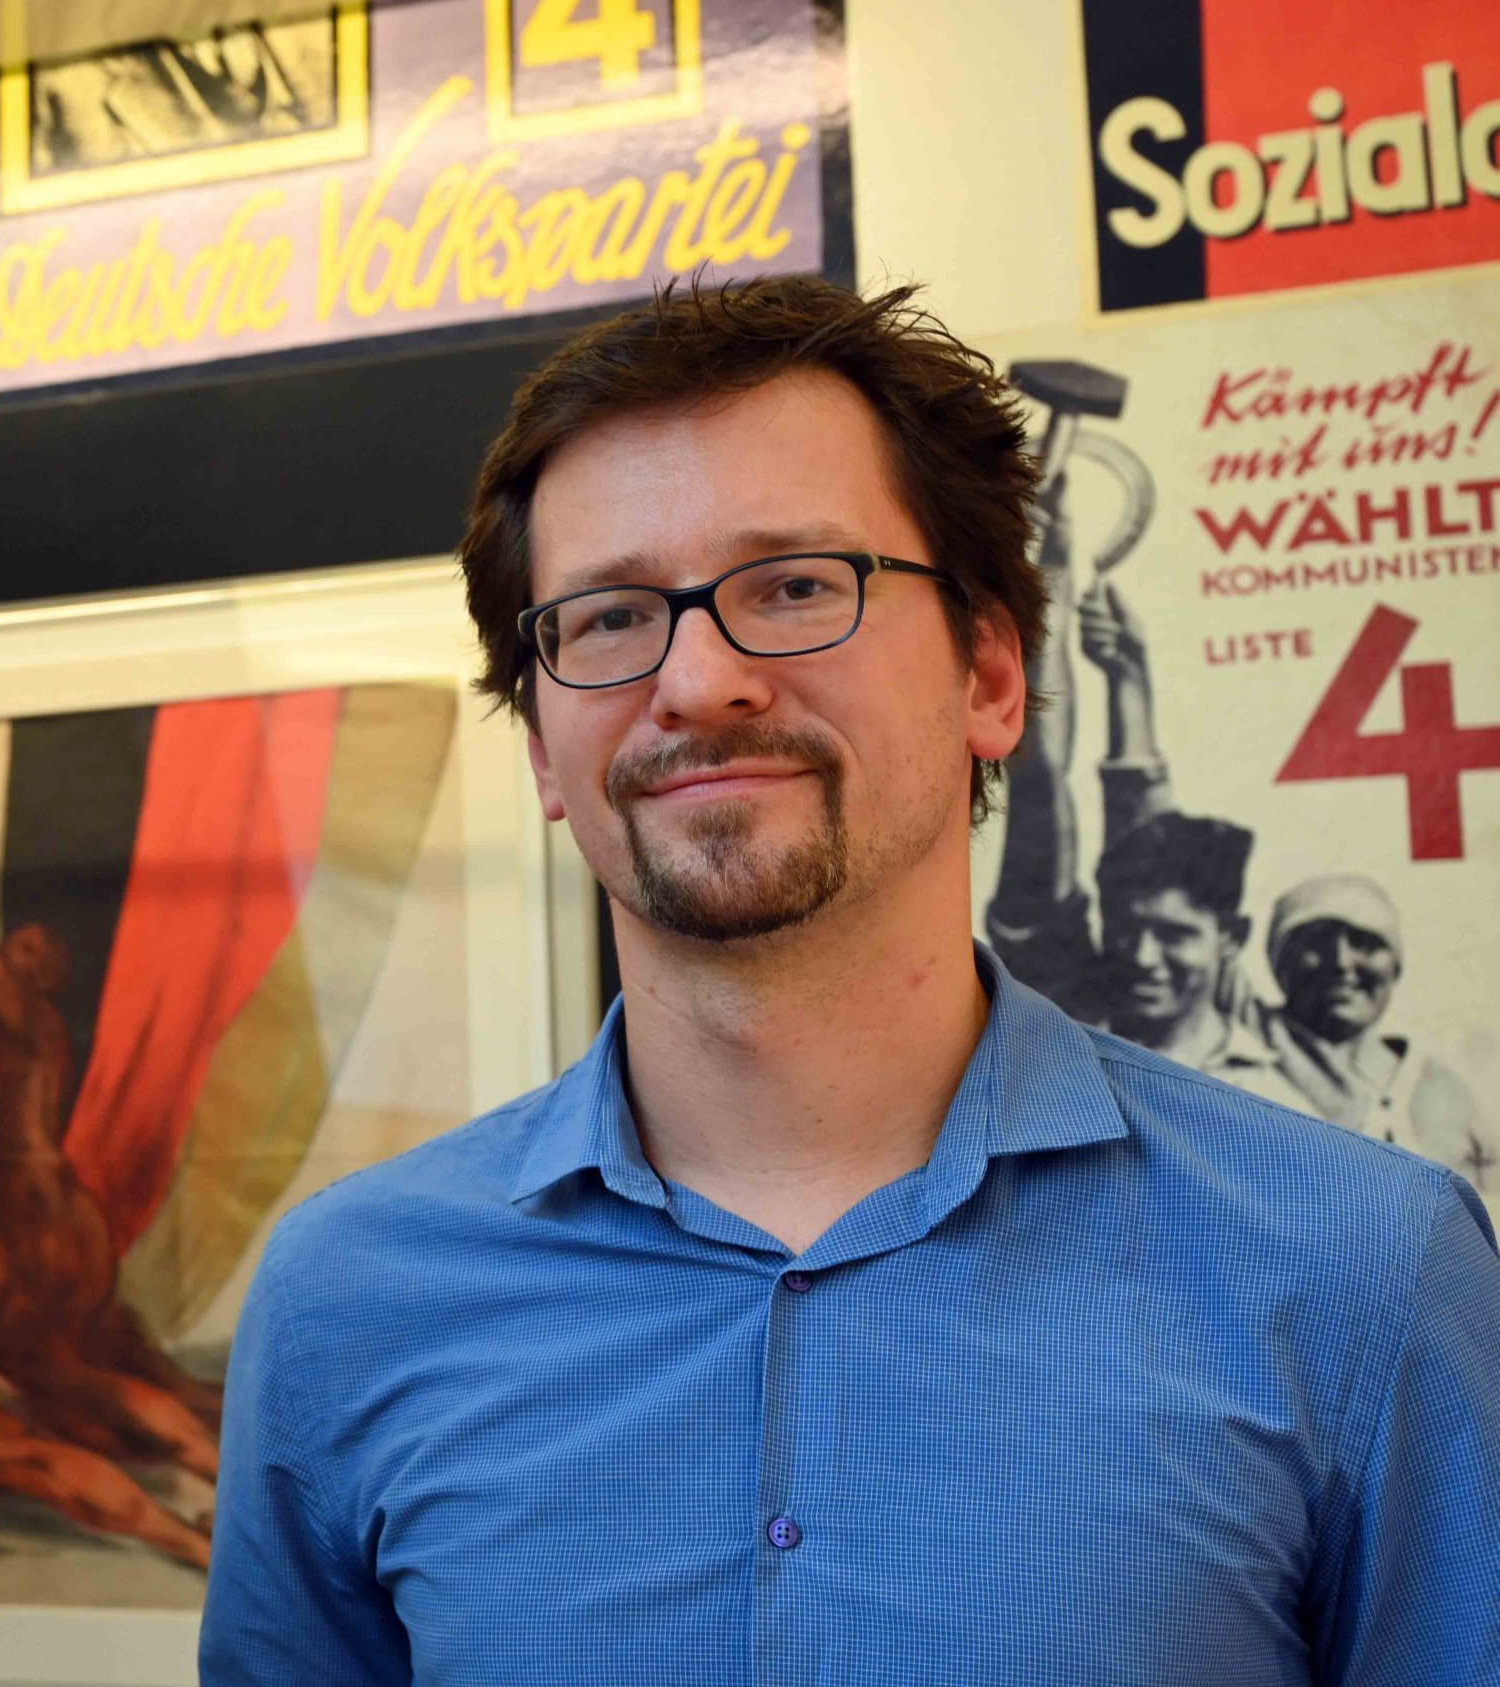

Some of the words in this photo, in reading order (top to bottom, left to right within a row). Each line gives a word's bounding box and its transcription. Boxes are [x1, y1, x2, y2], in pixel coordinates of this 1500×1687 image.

[521, 0, 655, 88] 4
[314, 75, 811, 321] Volkspartei
[1202, 343, 1490, 428] Kämpft
[1204, 423, 1327, 484] mit
[1196, 479, 1500, 553] WÄHLT
[1204, 628, 1313, 665] LISTE
[1273, 601, 1500, 862] 4
